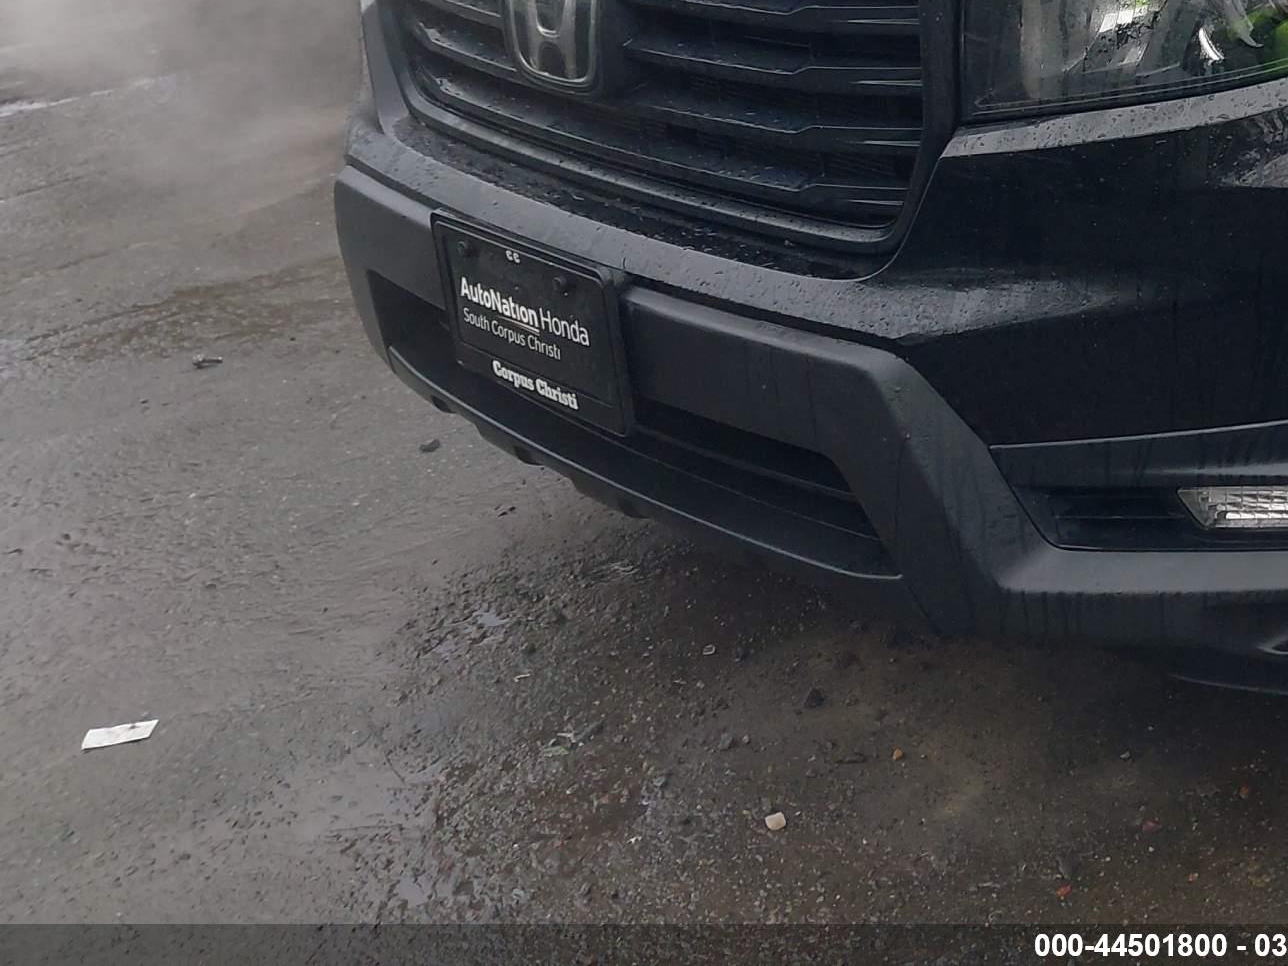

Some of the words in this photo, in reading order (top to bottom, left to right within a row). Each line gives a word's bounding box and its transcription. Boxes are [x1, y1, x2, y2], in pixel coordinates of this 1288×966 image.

[461, 277, 540, 328] AutoNation
[539, 307, 590, 347] Honda
[463, 307, 491, 332] South
[491, 320, 526, 346] Corpus
[527, 334, 561, 360] Christi
[492, 360, 535, 391] Corpus
[535, 378, 579, 410] Christi
